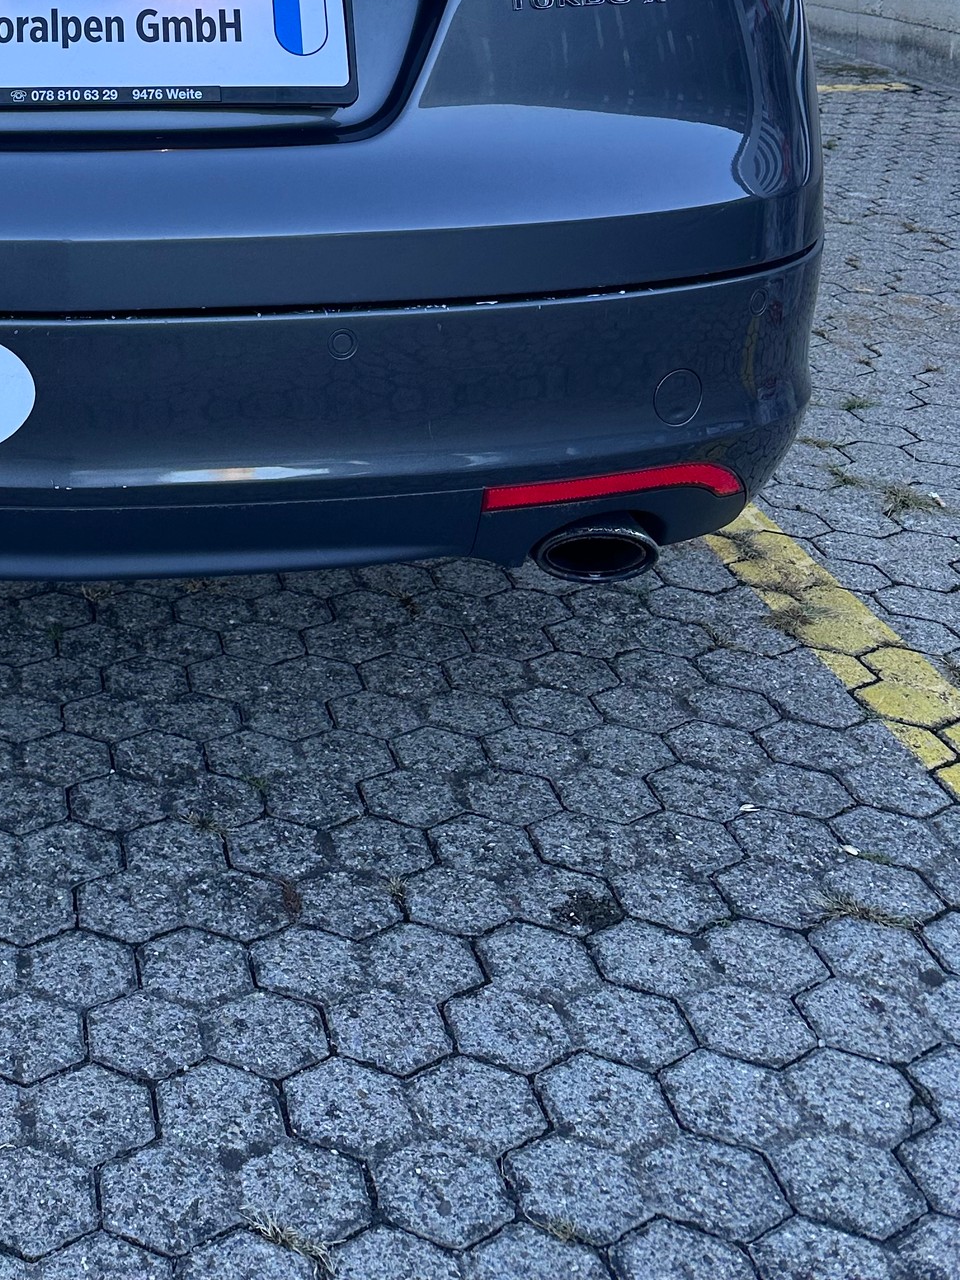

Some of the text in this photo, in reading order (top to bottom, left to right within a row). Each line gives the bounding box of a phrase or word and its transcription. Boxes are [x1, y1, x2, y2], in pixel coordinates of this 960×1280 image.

[135, 8, 242, 43] GmbH
[31, 90, 54, 101] 078
[57, 89, 81, 101] 810
[83, 89, 99, 101] 63
[102, 89, 118, 101] 29
[132, 88, 163, 100] 9476
[165, 88, 203, 100] Weite
